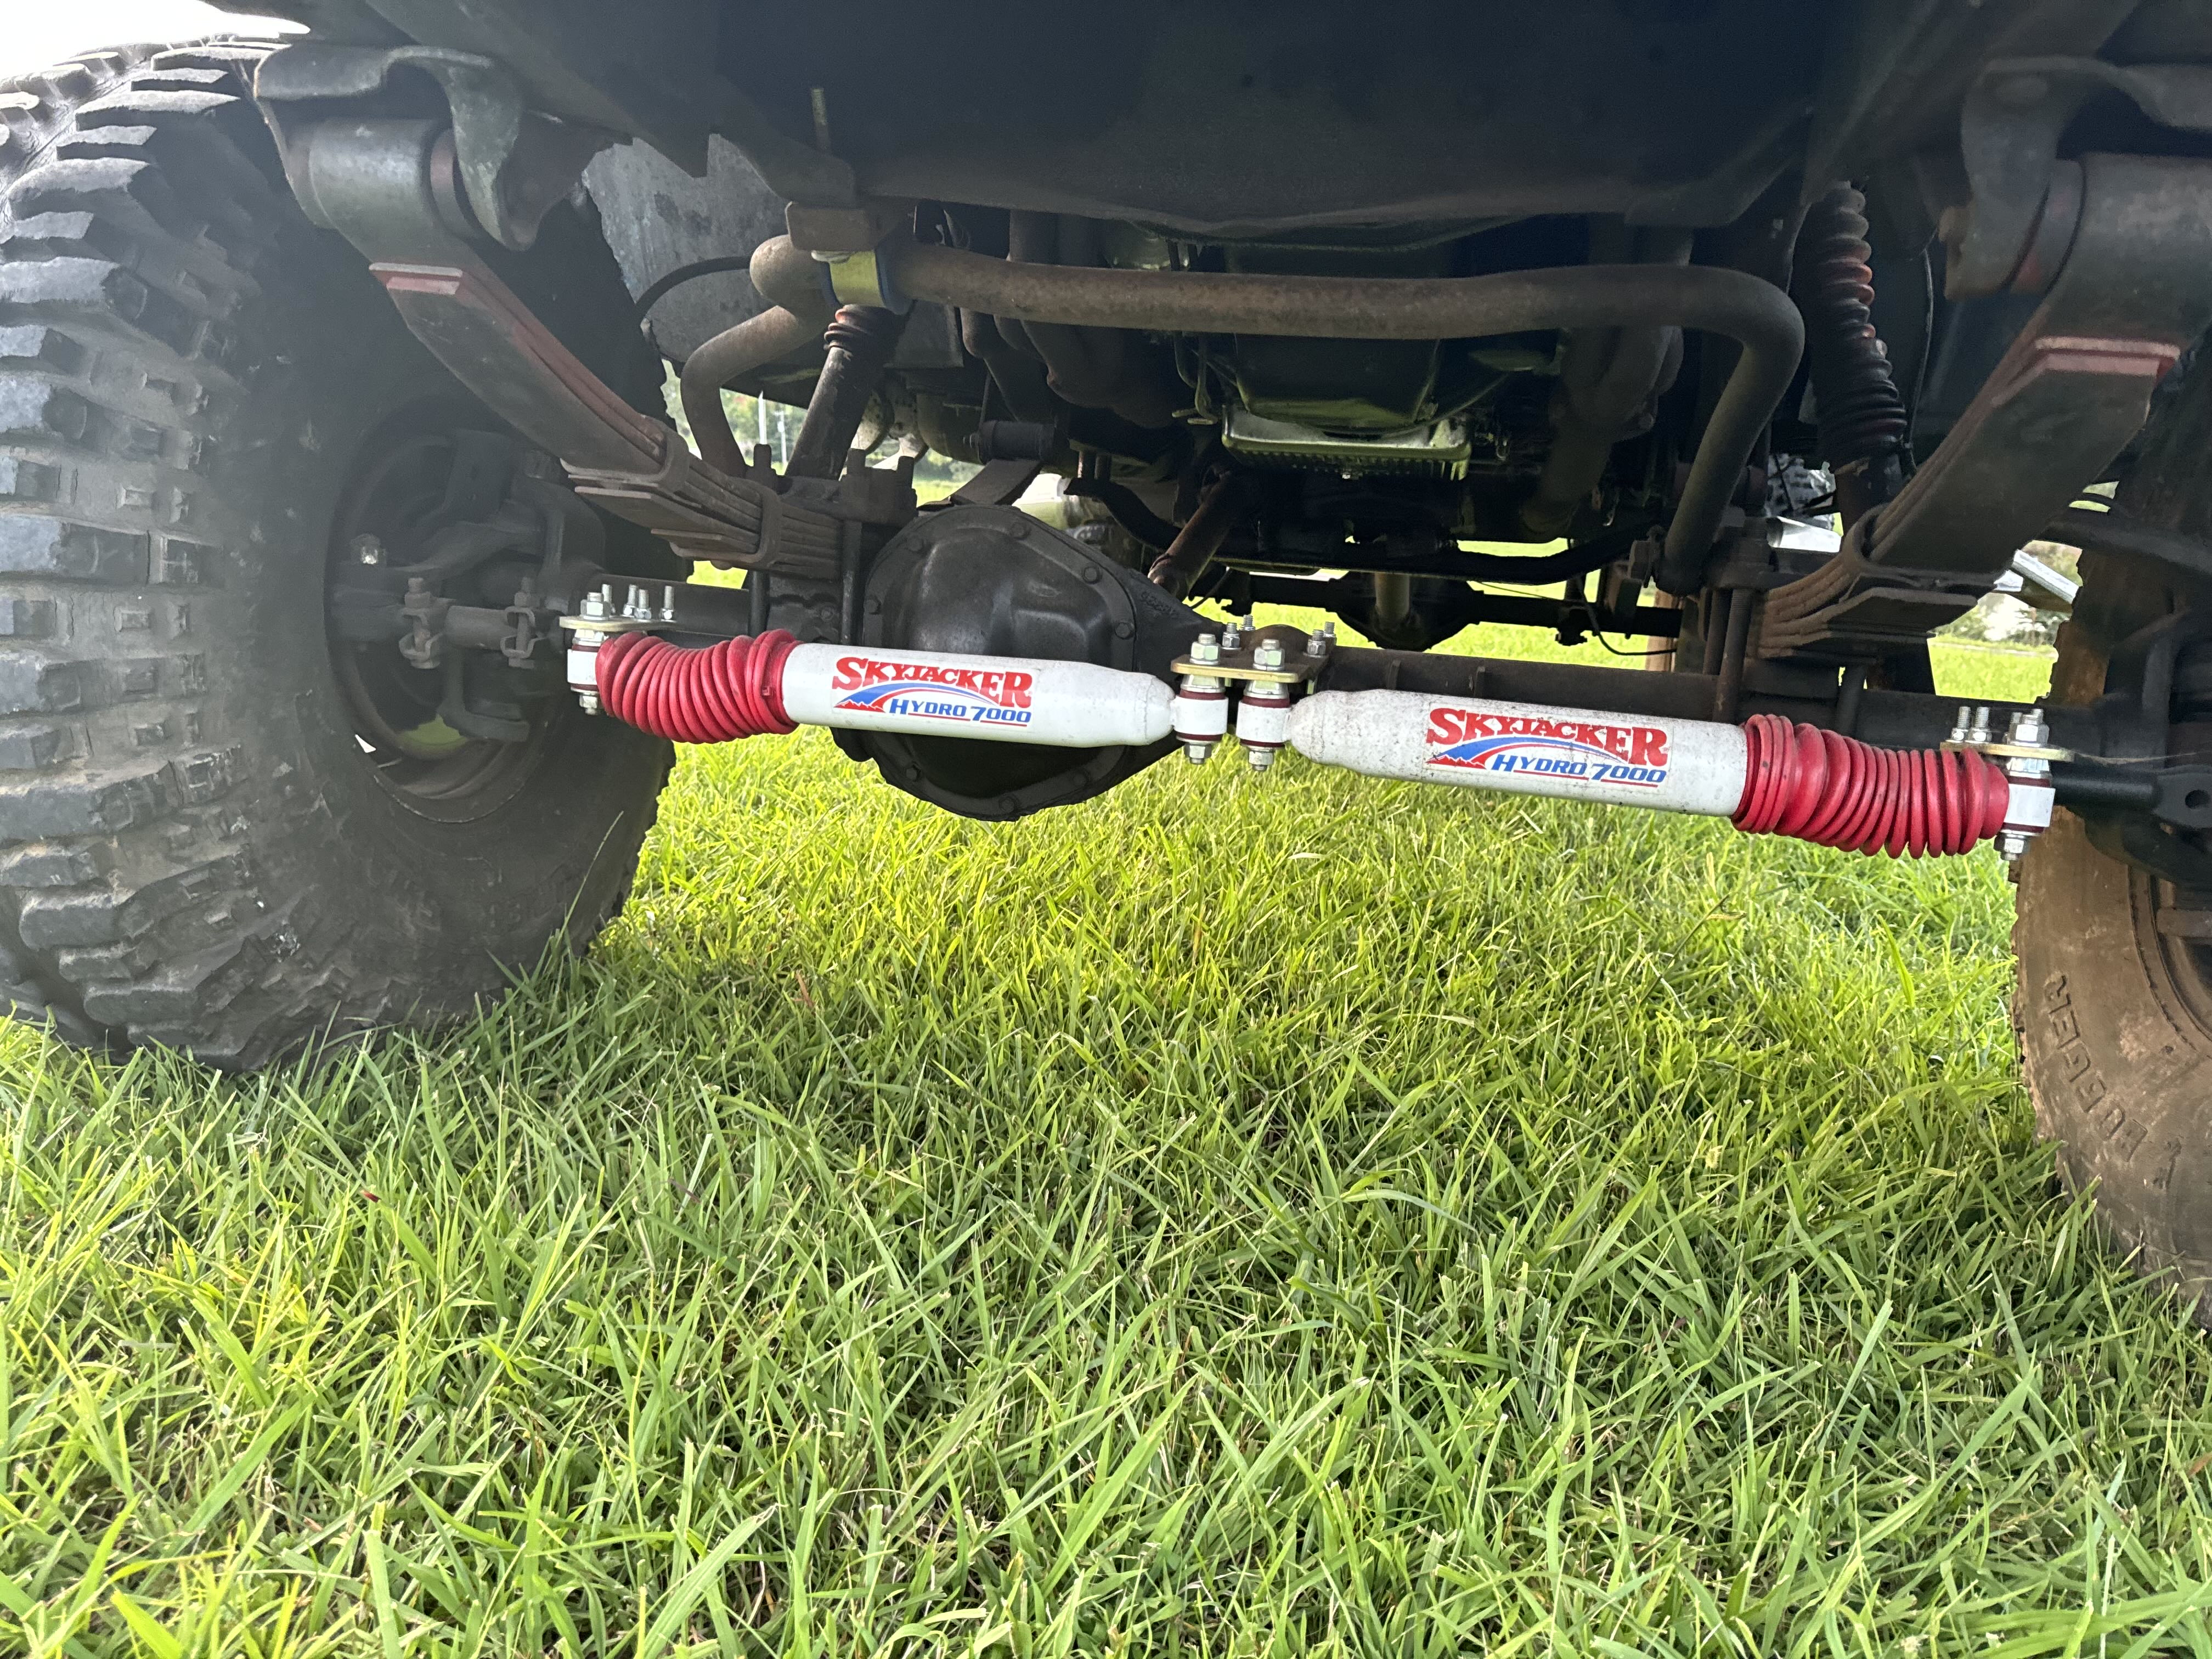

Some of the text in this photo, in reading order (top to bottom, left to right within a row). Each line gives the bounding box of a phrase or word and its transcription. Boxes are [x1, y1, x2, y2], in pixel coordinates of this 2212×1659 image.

[832, 657, 1032, 708] SKYJACKER
[889, 698, 1032, 723] HYDRO 7000
[1426, 708, 1669, 766] SKYJACKER
[1491, 754, 1667, 783] HYDRO 7000
